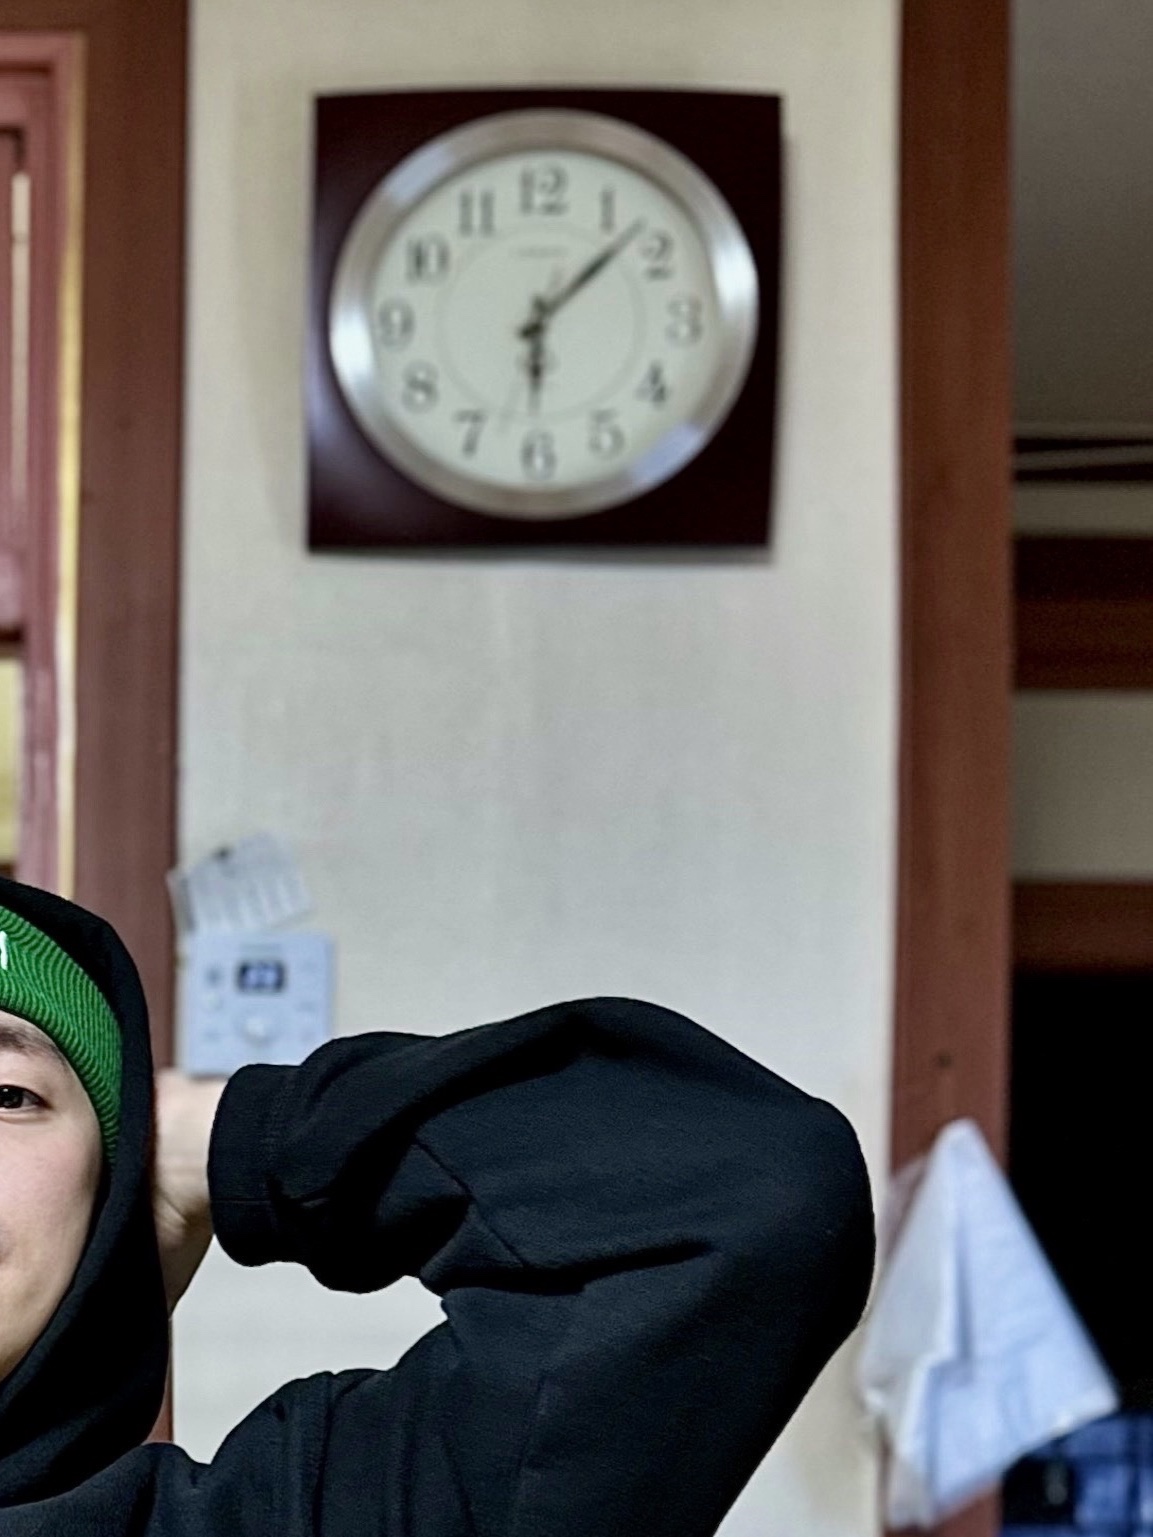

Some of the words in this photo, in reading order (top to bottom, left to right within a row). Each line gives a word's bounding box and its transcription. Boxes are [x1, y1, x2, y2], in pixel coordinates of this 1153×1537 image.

[458, 189, 494, 238] 11
[519, 165, 568, 216] 12
[599, 188, 615, 233] 1
[406, 234, 448, 284] 10
[642, 233, 673, 280] 2
[378, 299, 414, 348] 9
[665, 299, 702, 348] 3
[402, 360, 438, 411] 8
[638, 361, 670, 408] 4
[453, 408, 488, 457] 7
[520, 431, 557, 481] 6
[589, 408, 624, 459] 5
